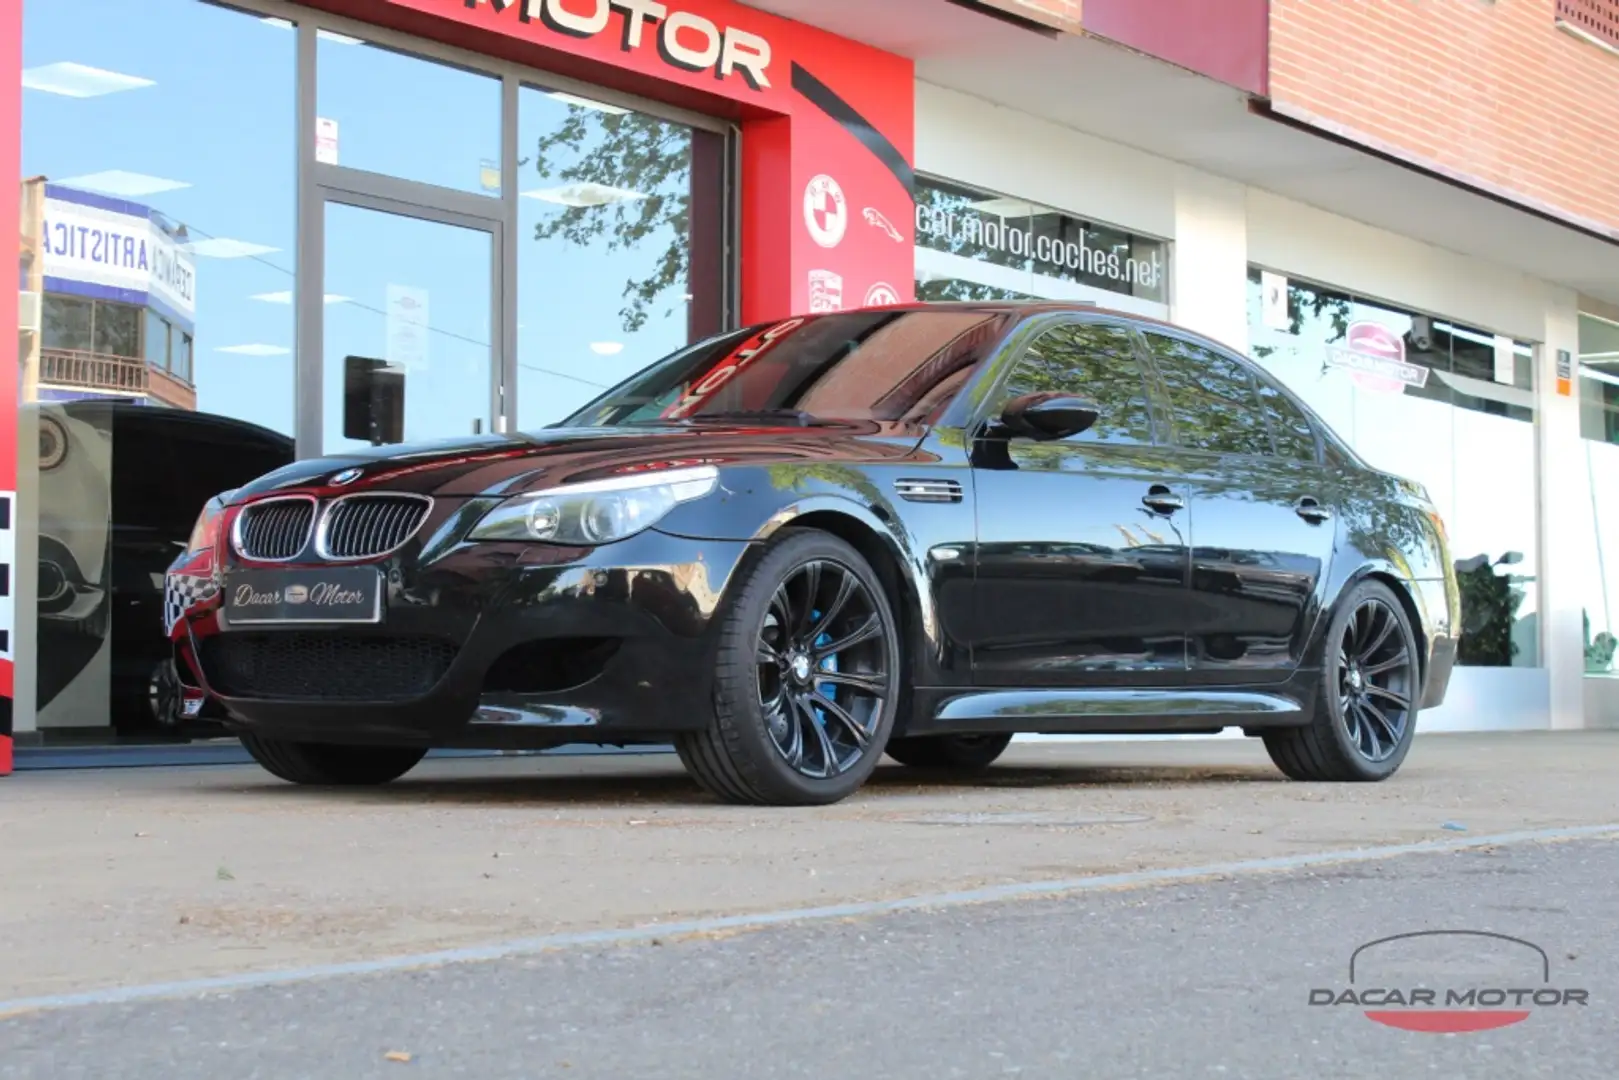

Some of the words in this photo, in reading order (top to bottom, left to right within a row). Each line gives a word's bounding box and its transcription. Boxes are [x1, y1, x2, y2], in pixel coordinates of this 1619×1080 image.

[464, 0, 771, 90] OTOR
[233, 583, 282, 607] Dacar
[309, 581, 365, 606] Motor
